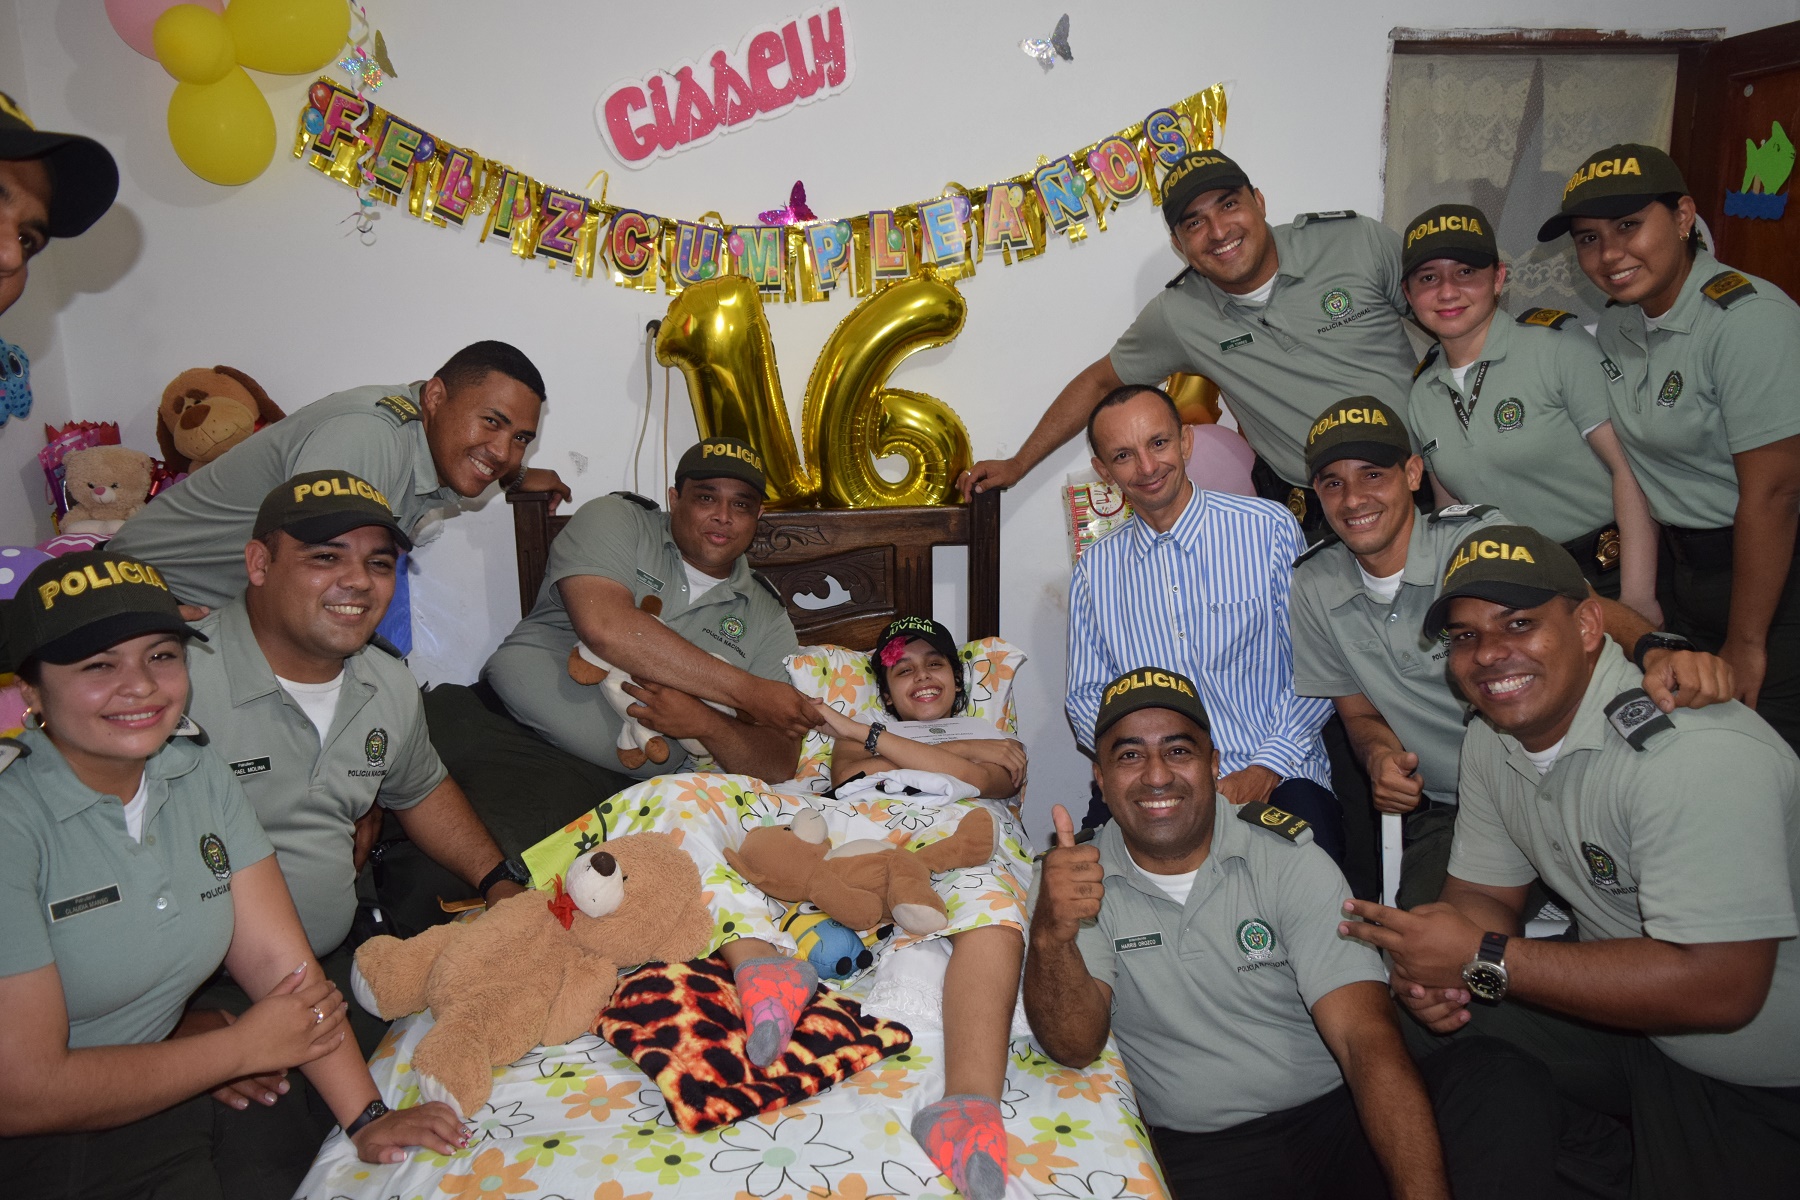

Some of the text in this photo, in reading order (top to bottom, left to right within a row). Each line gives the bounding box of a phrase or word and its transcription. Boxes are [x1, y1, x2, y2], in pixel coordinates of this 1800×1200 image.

[604, 6, 848, 161] Gissely
[311, 89, 1191, 290] FELIZ CUMPLEAÑOS
[1163, 156, 1226, 198] POLICIA
[1563, 157, 1642, 201] POLICIA
[1406, 215, 1483, 248] POLICIA
[1317, 307, 1371, 334] POLICIA NACIONAL
[1309, 409, 1389, 445] POLICIA
[702, 442, 764, 473] POLICIA
[294, 477, 391, 513] POLICIA
[38, 560, 168, 610] POLICIA
[701, 627, 746, 659] POLICIA NACIONAL
[885, 622, 937, 639] JUVENIL
[1431, 650, 1450, 662] POLIC
[1105, 671, 1194, 704] POLICIA
[247, 764, 266, 773] MOLINA
[347, 769, 370, 778] POLICIA
[1610, 886, 1639, 896] NACIO
[1120, 939, 1157, 950] HARRIS OROZCO
[1237, 959, 1290, 973] POLICIA NACIONA
